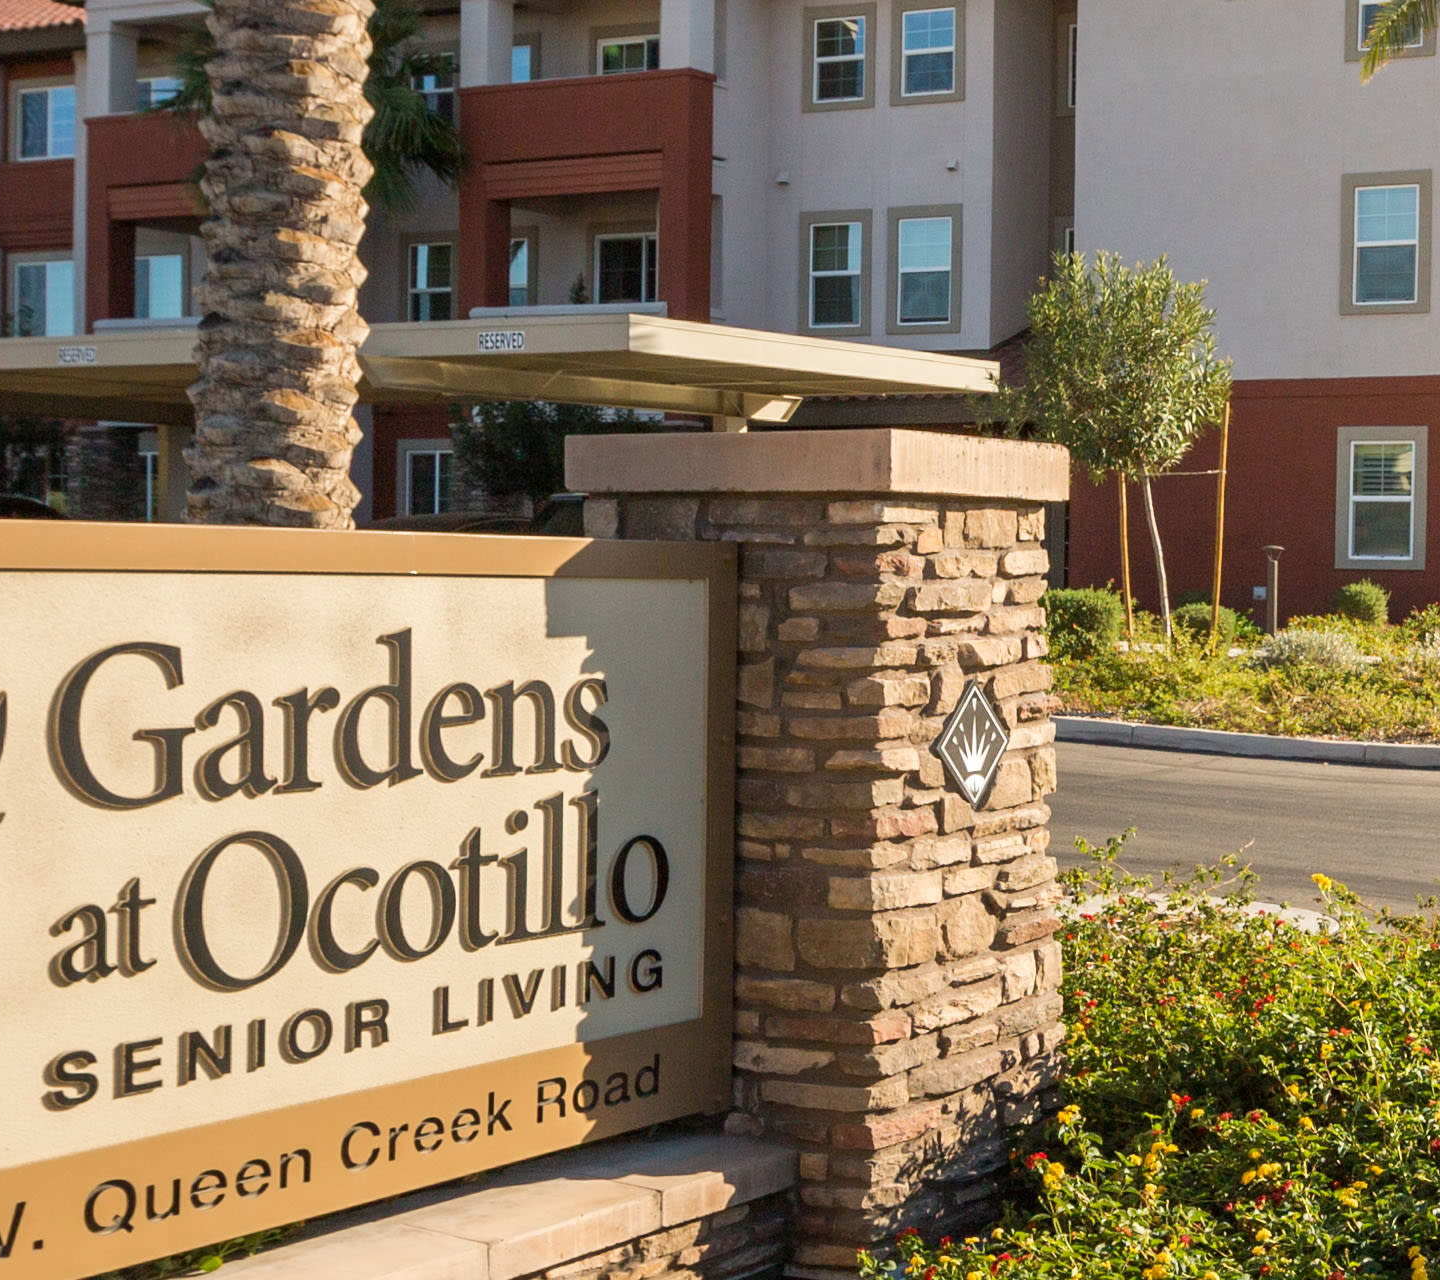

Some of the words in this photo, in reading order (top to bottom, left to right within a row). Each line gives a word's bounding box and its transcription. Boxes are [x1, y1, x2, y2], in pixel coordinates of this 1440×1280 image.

[478, 331, 524, 350] RESERVED
[46, 627, 611, 811] Gardens
[47, 876, 158, 988] at
[172, 789, 670, 993] Ocotillo
[41, 997, 390, 1112] SENIOR
[431, 948, 664, 1037] LIVING
[83, 1145, 313, 1236] Queen
[339, 1091, 513, 1172] Creek
[536, 1052, 661, 1124] Road
